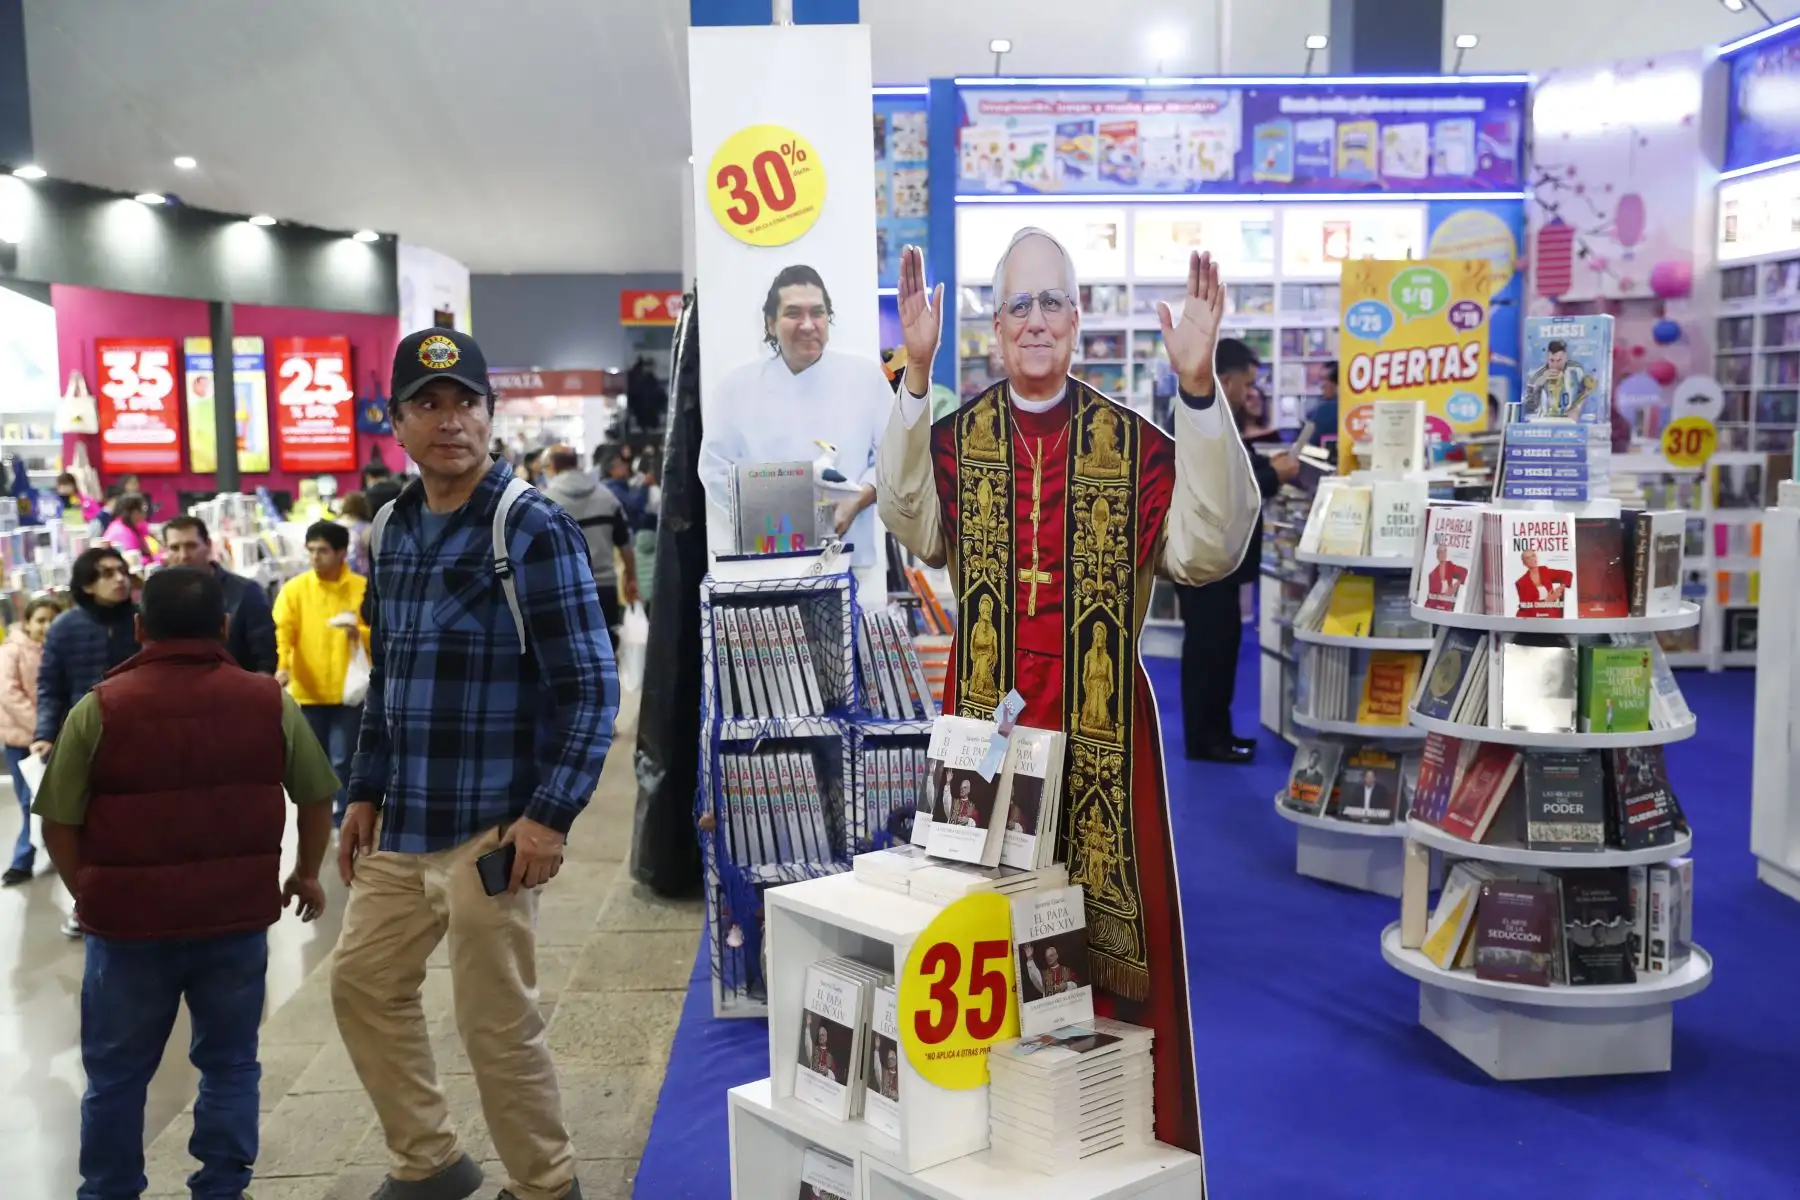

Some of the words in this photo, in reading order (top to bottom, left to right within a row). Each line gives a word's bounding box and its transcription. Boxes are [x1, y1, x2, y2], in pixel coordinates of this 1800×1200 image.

[1540, 323, 1586, 338] MESSI
[101, 351, 173, 401] 35
[1350, 341, 1480, 391] OFERTAS
[279, 358, 353, 404] 25
[765, 514, 793, 535] LA
[1513, 522, 1527, 536] LA
[1528, 521, 1568, 536] PAREJA
[755, 533, 805, 553] MAR
[1444, 534, 1471, 549] EXISTE
[1513, 538, 1529, 551] NO
[1530, 537, 1568, 551] EXISTE
[717, 638, 727, 666] MAR
[730, 639, 743, 668] MAR
[744, 639, 756, 667] MAR
[758, 638, 770, 667] MAR
[771, 639, 784, 667] MAR
[784, 637, 796, 665] MAR
[797, 636, 810, 664] MAR
[961, 745, 972, 755] EL
[973, 746, 987, 756] PAP
[730, 786, 740, 814] MAR
[744, 787, 753, 815] MAR
[757, 787, 768, 814] MAR
[770, 786, 781, 814] MAR
[783, 784, 795, 812] MAR
[796, 784, 808, 813] MAR
[808, 785, 820, 813] MAR
[1543, 804, 1584, 814] PODER
[1030, 922, 1055, 938] LEÓN
[1056, 916, 1075, 930] XIV
[1034, 914, 1043, 924] EL
[1047, 908, 1069, 920] PAPA
[1488, 929, 1542, 943] SEDUCCIÓN
[817, 989, 825, 999] EL
[826, 992, 843, 1006] PAPA
[914, 940, 1008, 1044] 35
[936, 1050, 955, 1060] APLICA
[961, 1048, 978, 1057] OTRAS
